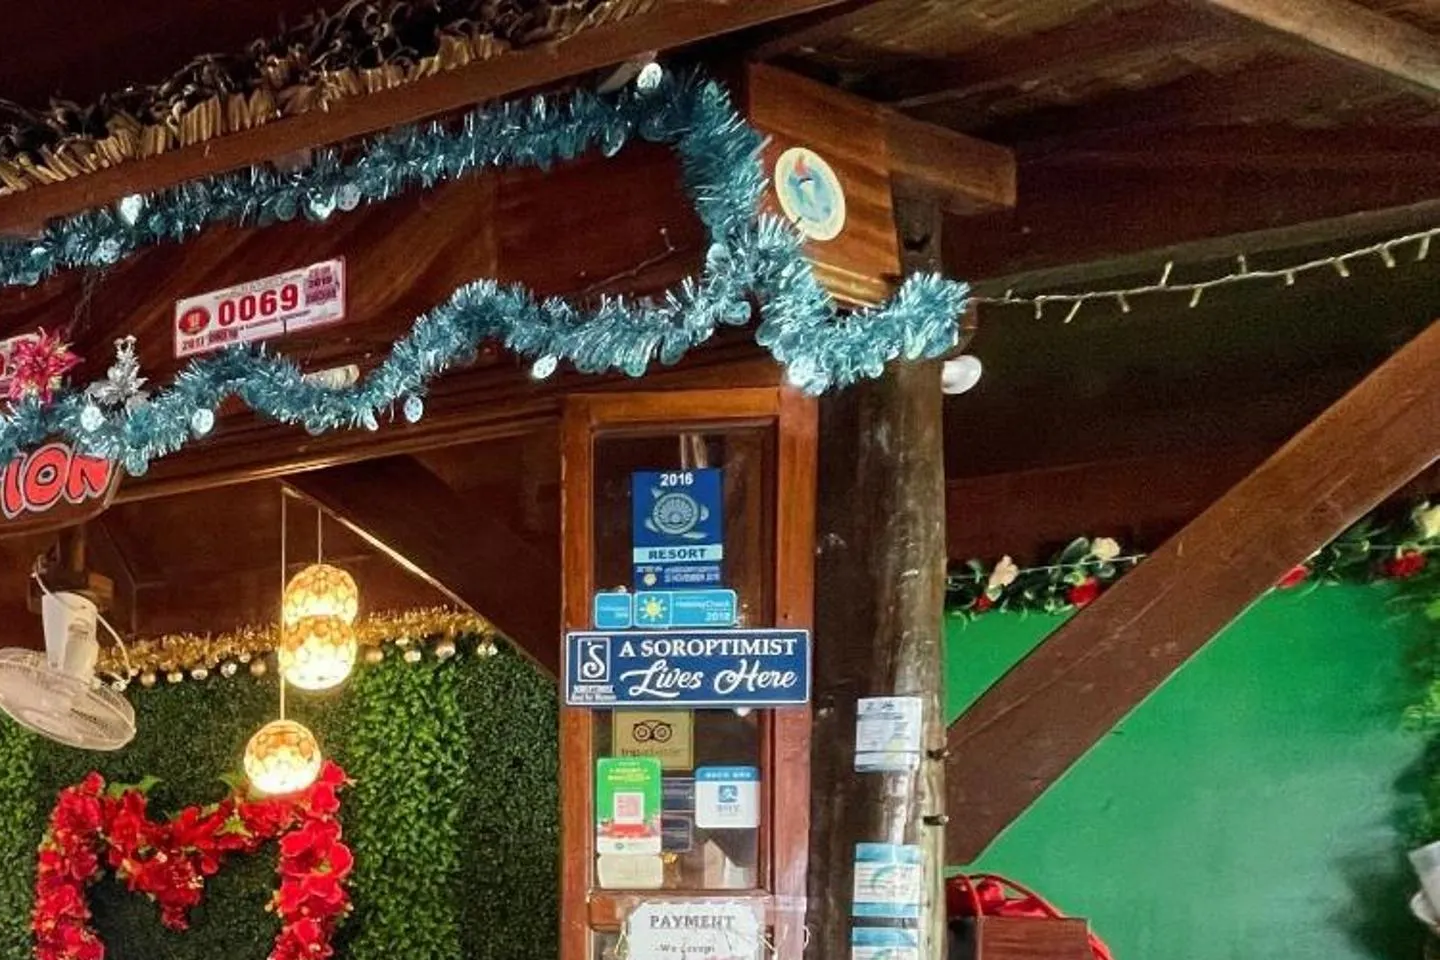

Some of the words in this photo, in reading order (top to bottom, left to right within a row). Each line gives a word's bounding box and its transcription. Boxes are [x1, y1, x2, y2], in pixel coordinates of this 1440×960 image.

[218, 284, 299, 327] 0069
[648, 548, 708, 560] RESORT
[619, 641, 636, 657] A
[641, 638, 798, 657] SOROPTIMIST
[620, 658, 704, 698] Lives
[714, 658, 798, 694] Here
[650, 915, 735, 929] PAYMENT
